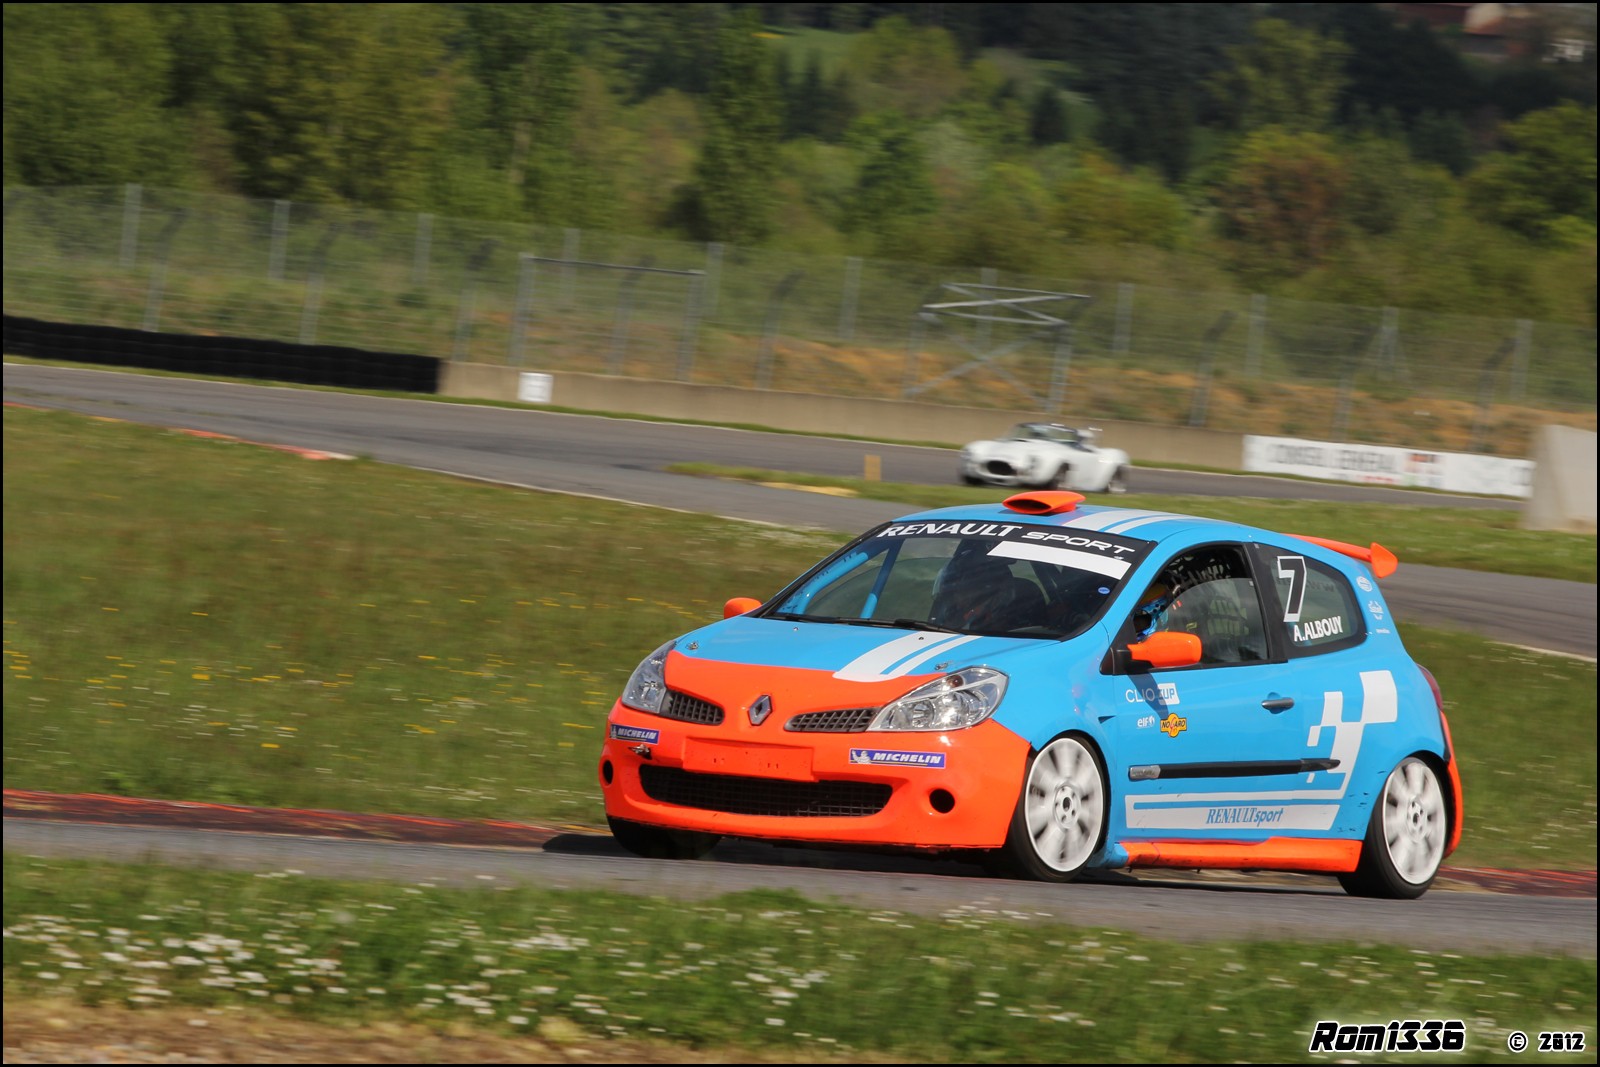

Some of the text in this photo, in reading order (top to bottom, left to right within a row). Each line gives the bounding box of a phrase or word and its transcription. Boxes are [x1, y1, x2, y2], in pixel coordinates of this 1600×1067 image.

[877, 523, 1135, 554] RENAULT SPORT
[1277, 556, 1307, 622] 7
[1294, 616, 1343, 641] A.ALBOUY
[1125, 688, 1155, 702] CLIO
[616, 728, 658, 741] MICHELIN
[872, 752, 941, 765] MICHELIN
[1206, 807, 1283, 827] RENAULTsport
